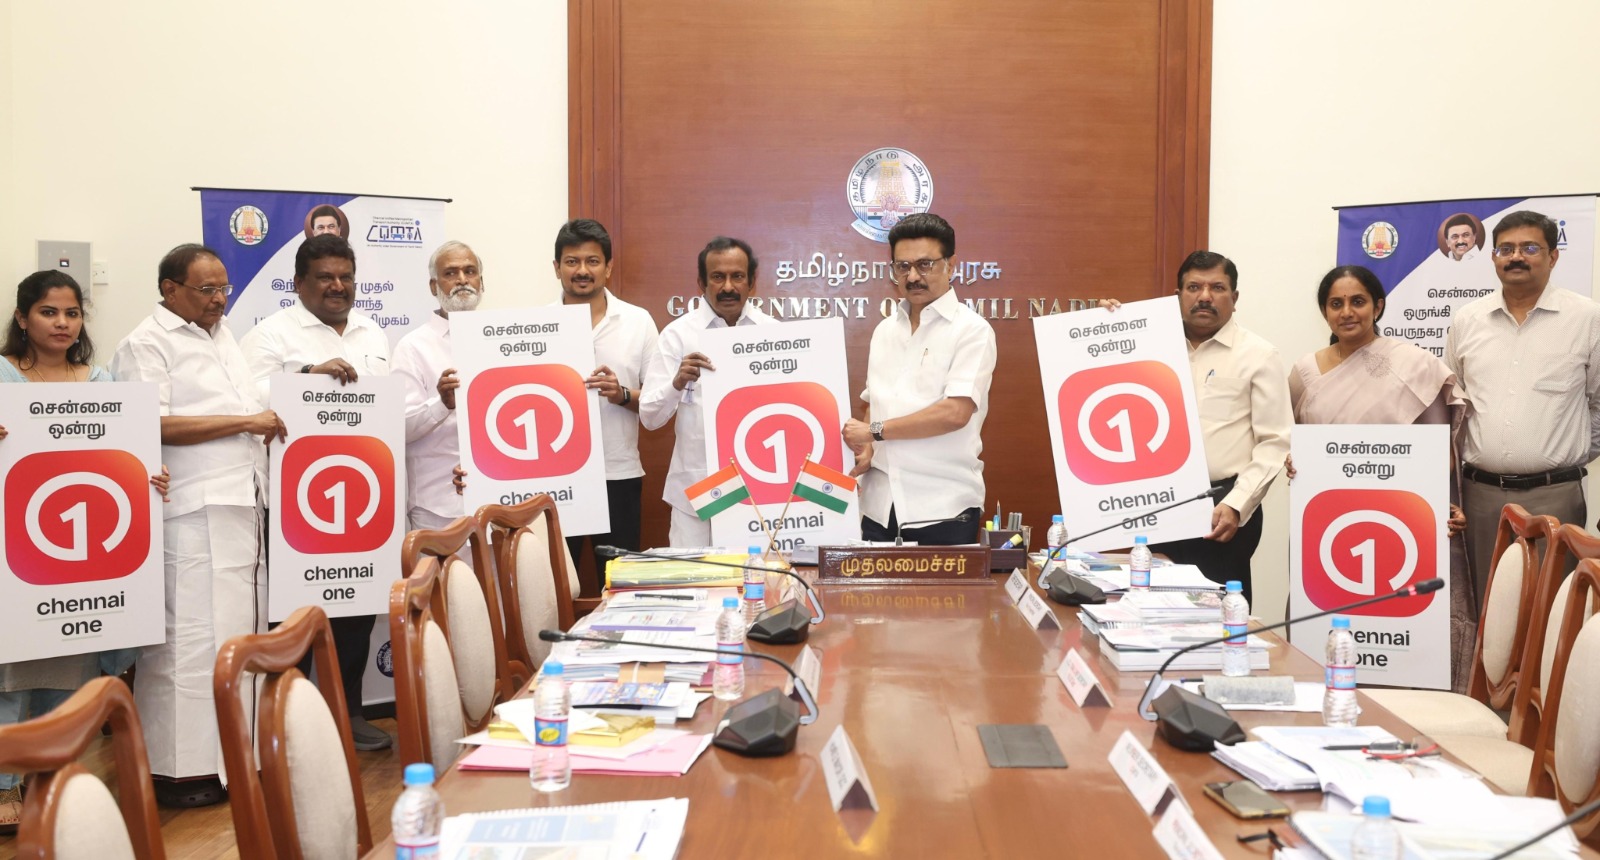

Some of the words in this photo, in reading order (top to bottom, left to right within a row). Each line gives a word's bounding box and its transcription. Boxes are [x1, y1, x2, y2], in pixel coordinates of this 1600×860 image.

[776, 252, 899, 286] தமிழ்நா
[1403, 305, 1451, 320] ஒருங்கி
[482, 322, 560, 337] சென்னை
[1068, 318, 1148, 340] சென்னை
[1383, 326, 1444, 340] பெருநகர
[499, 340, 547, 357] ஒன்று
[732, 338, 811, 355] சென்னை
[1087, 338, 1136, 357] ஒன்று
[748, 357, 798, 375] ஒன்று
[302, 390, 376, 404] சென்னை
[29, 400, 123, 415] சென்னை
[316, 409, 362, 426] ஒன்று
[48, 420, 106, 439] ஒன்று
[1325, 441, 1412, 455] சென்னை
[1342, 461, 1395, 480] ஒன்று
[499, 486, 573, 506] chenai
[1098, 487, 1175, 511] chennai
[748, 511, 824, 532] chennai
[1122, 513, 1158, 530] one
[303, 563, 374, 581] chennai
[841, 554, 967, 577] முதலமைச்சர்
[322, 587, 356, 601] one
[36, 591, 125, 615] chennai
[61, 619, 103, 636] one
[1329, 629, 1410, 646] ennai
